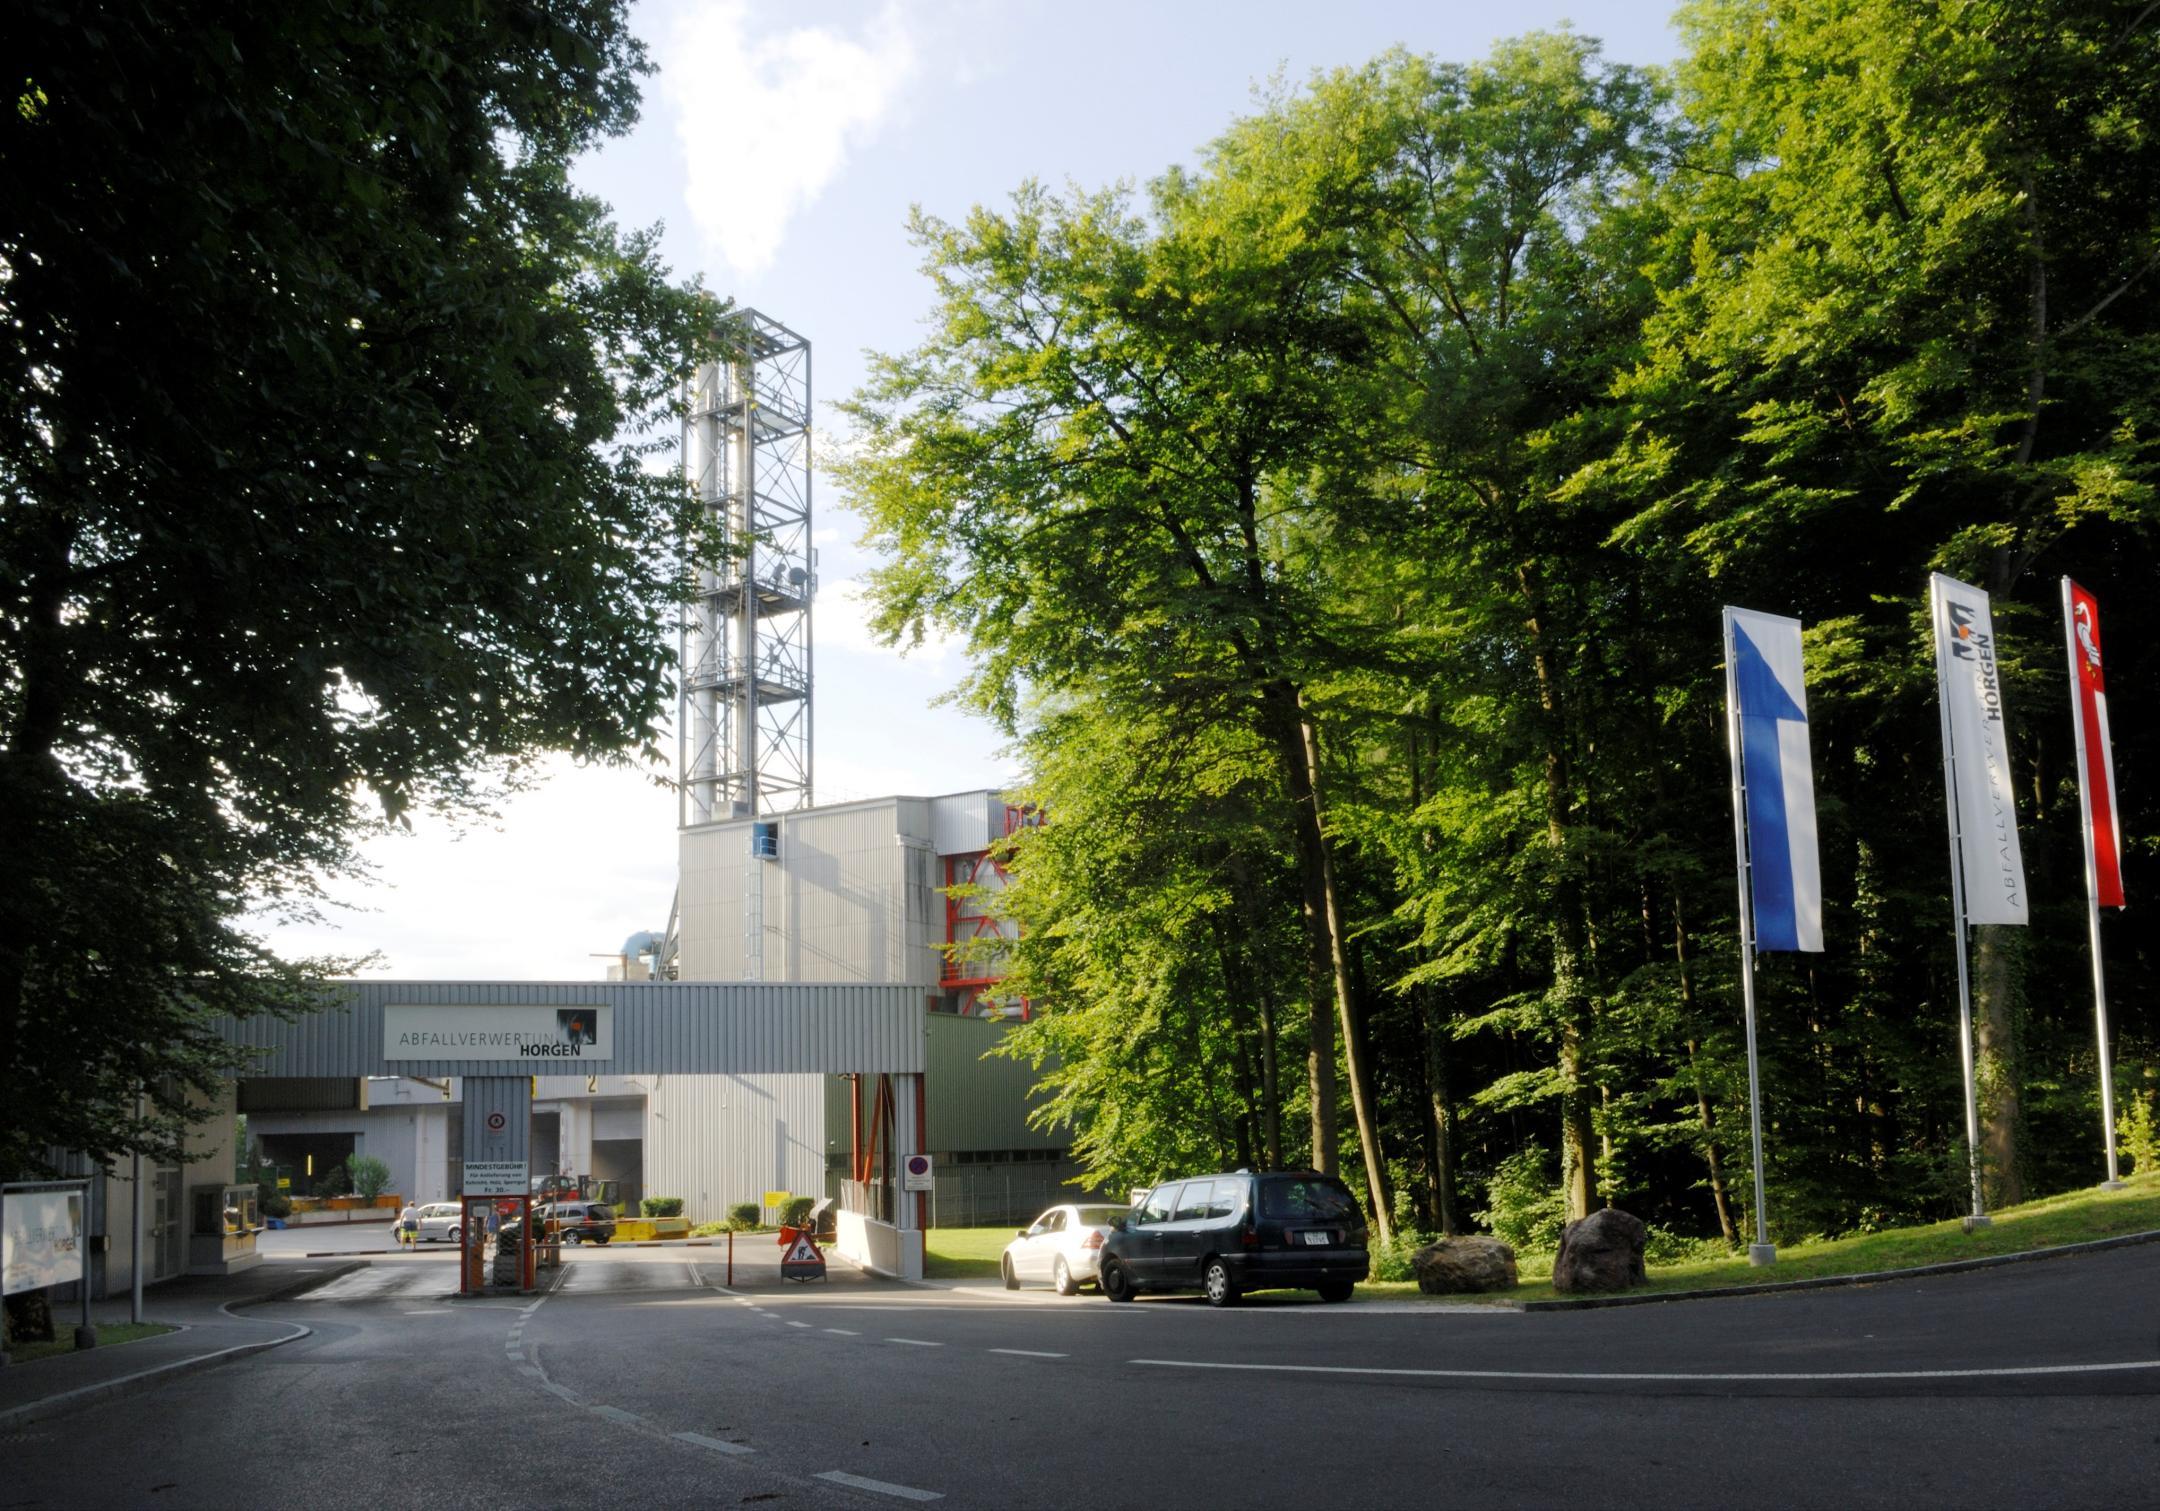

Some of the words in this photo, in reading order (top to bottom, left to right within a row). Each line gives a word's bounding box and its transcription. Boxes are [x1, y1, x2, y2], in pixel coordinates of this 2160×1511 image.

[1976, 634, 2001, 721] HORGEN
[400, 1032, 555, 1046] ABFALLVERWERTUN
[520, 1044, 581, 1057] HORGEN
[588, 1075, 597, 1093] 2
